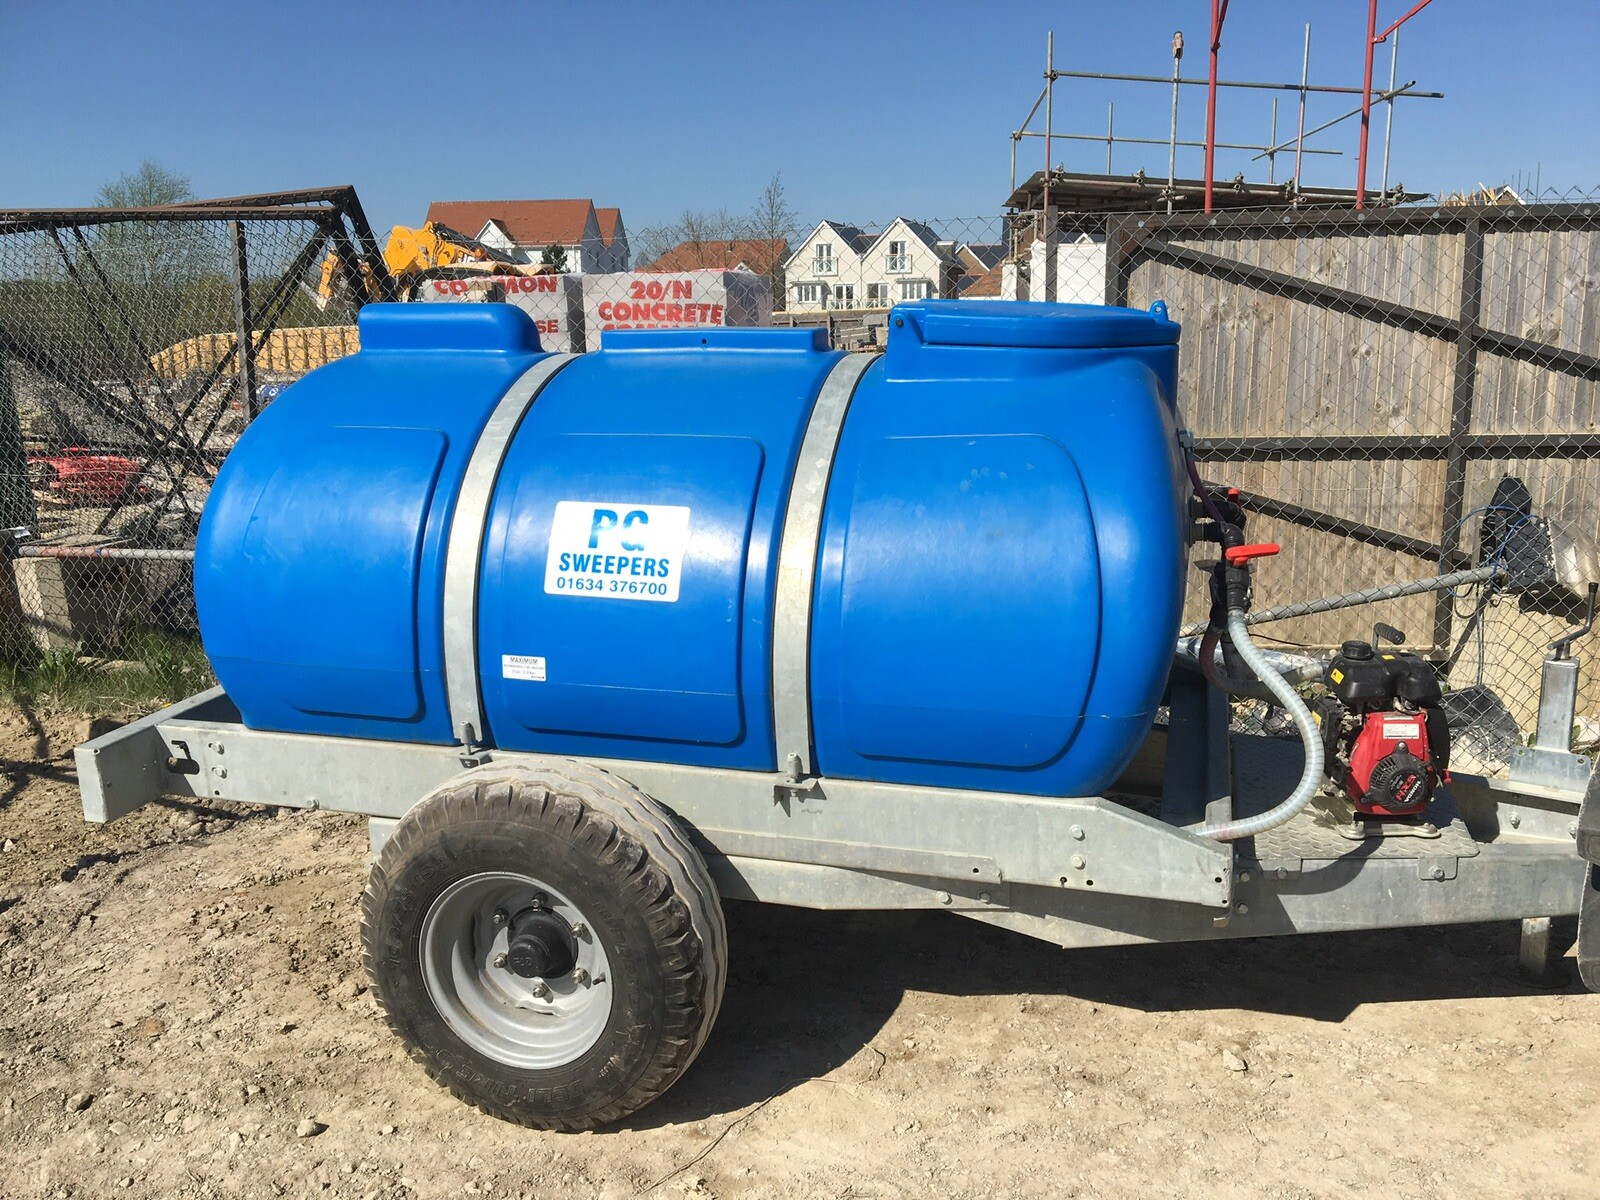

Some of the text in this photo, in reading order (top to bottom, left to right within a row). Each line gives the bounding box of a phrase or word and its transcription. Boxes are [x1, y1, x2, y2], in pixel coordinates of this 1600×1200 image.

[630, 280, 692, 301] 20/N
[598, 302, 724, 325] CONCRETE
[588, 508, 649, 552] PC
[558, 552, 670, 578] SWEEPERS
[556, 576, 668, 596] 01634 376700
